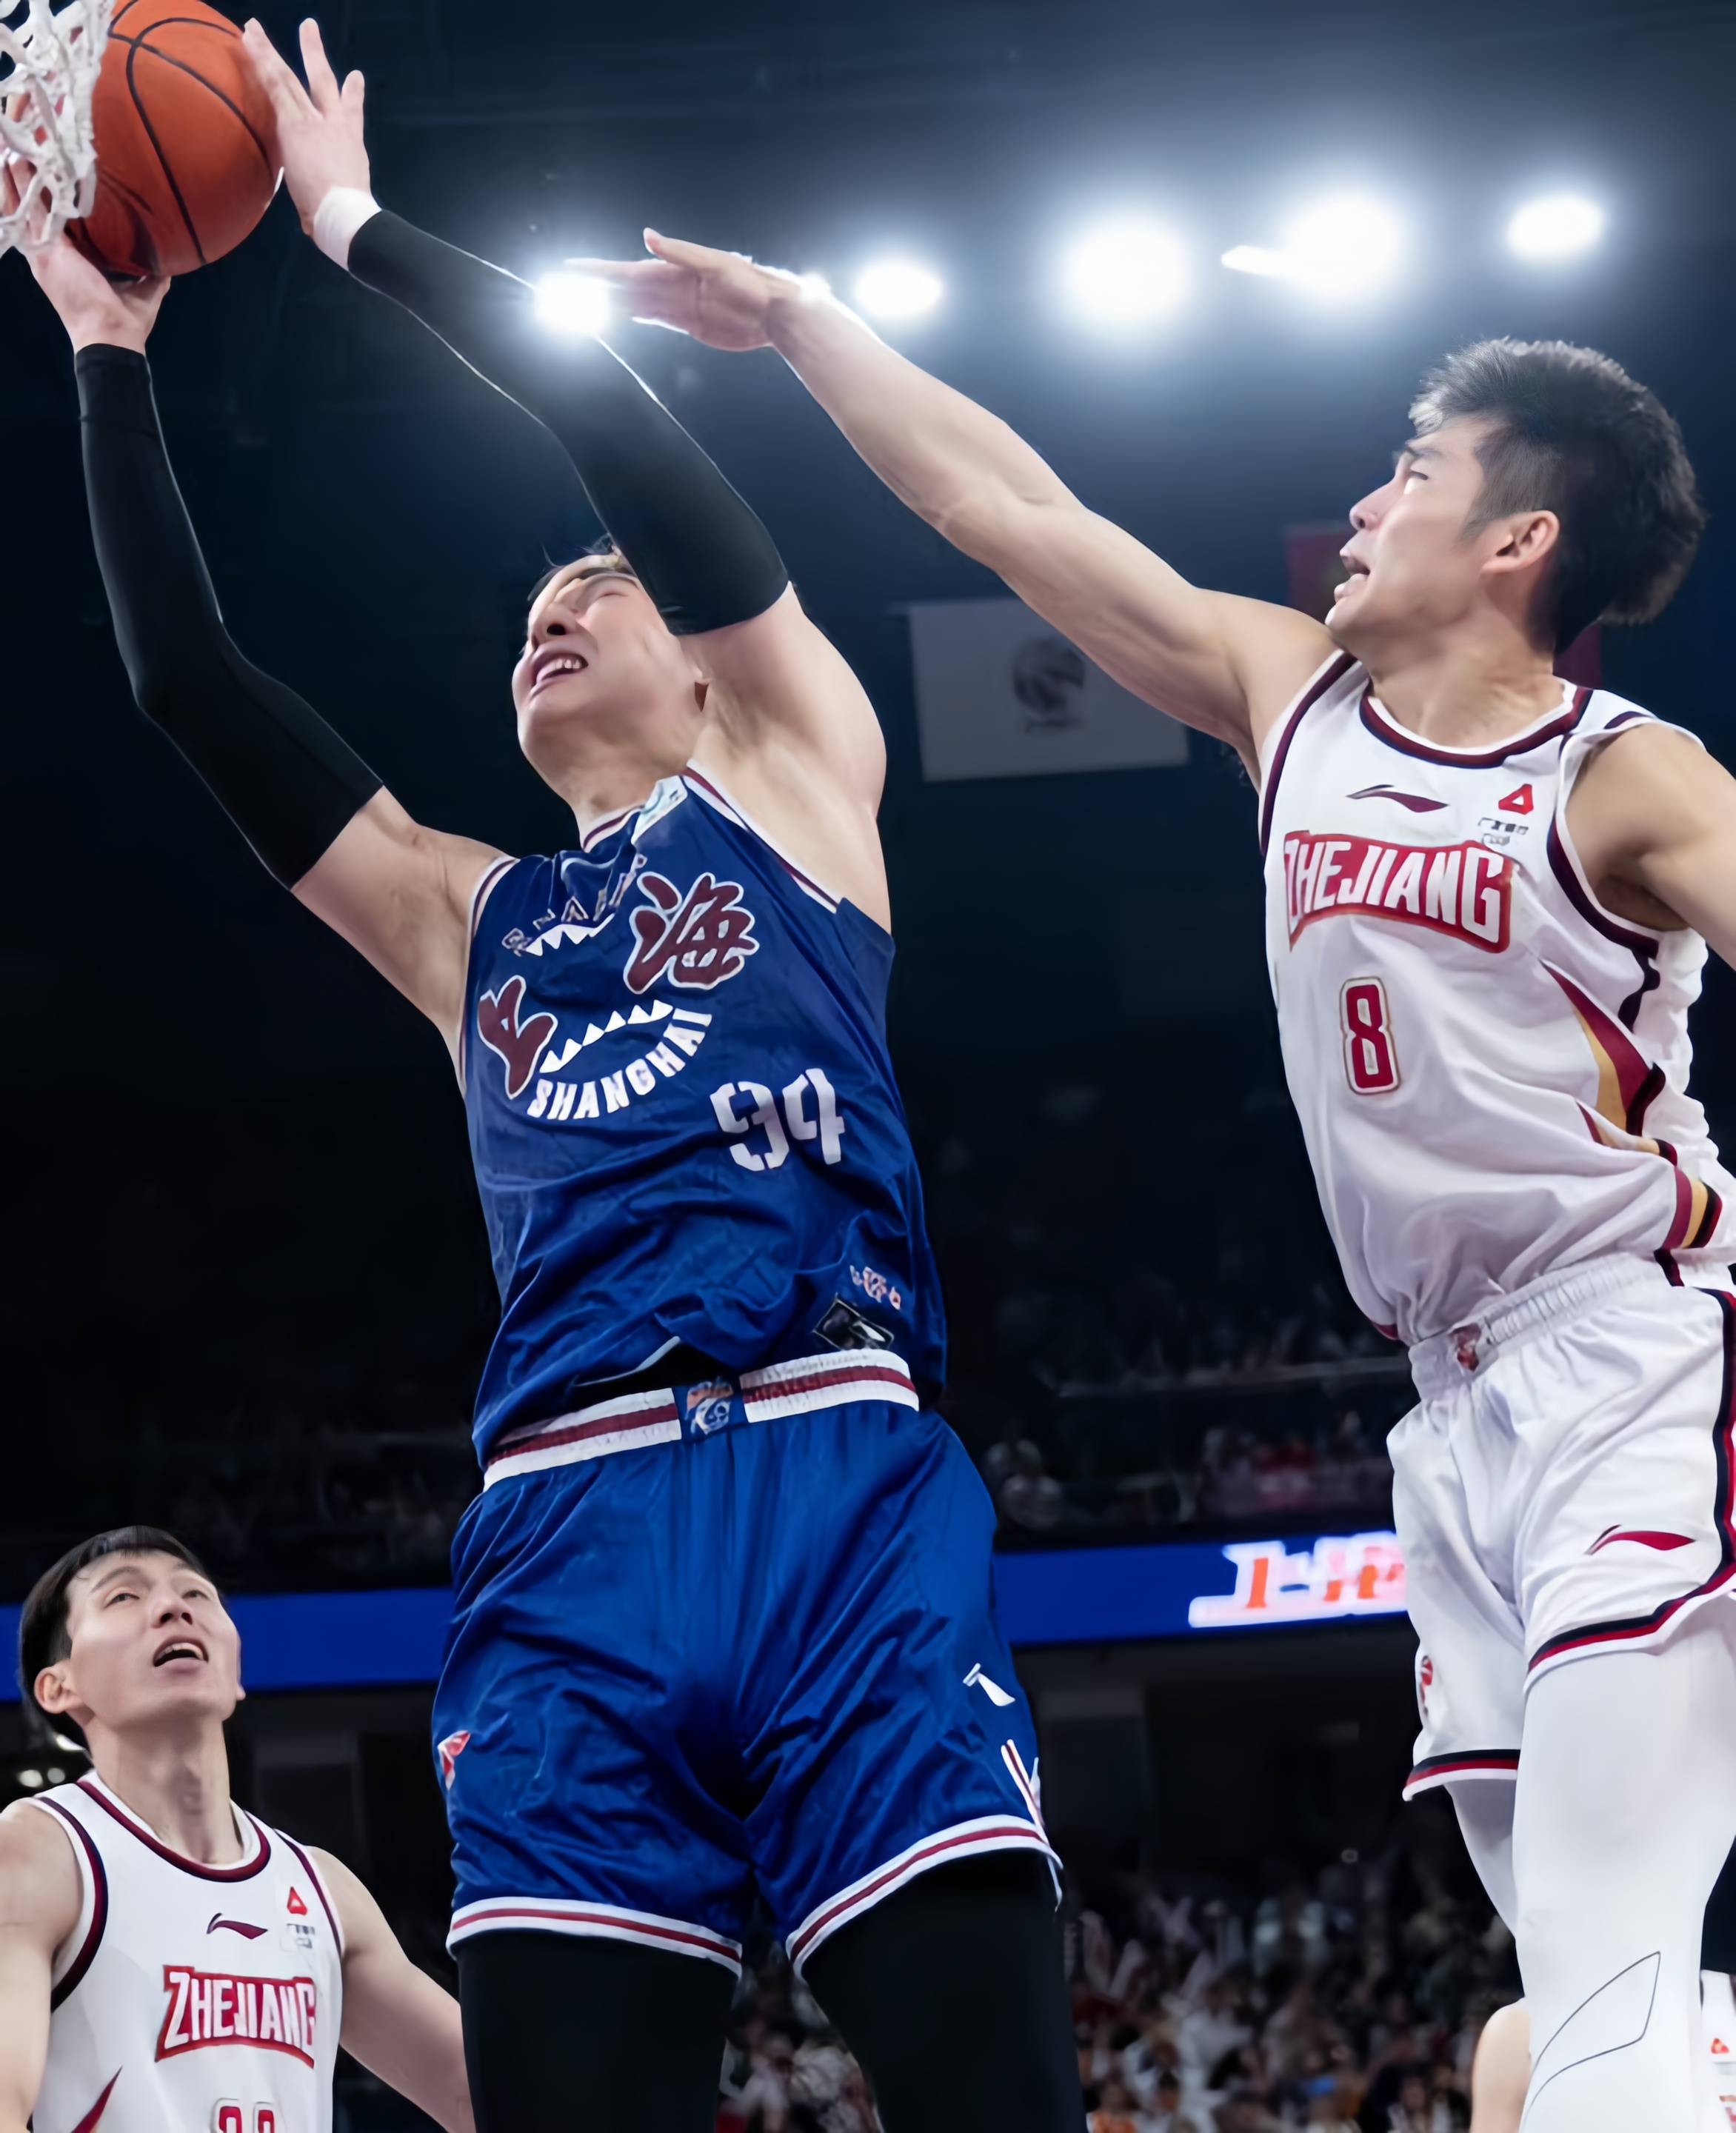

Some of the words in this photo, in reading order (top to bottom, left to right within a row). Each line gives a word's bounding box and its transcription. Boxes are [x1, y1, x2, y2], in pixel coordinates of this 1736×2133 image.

[527, 1008, 712, 1121] SHANGHAI
[1344, 981, 1398, 1092] 8
[709, 1067, 845, 1172] 94
[161, 1969, 317, 2052] ZHEJIANG
